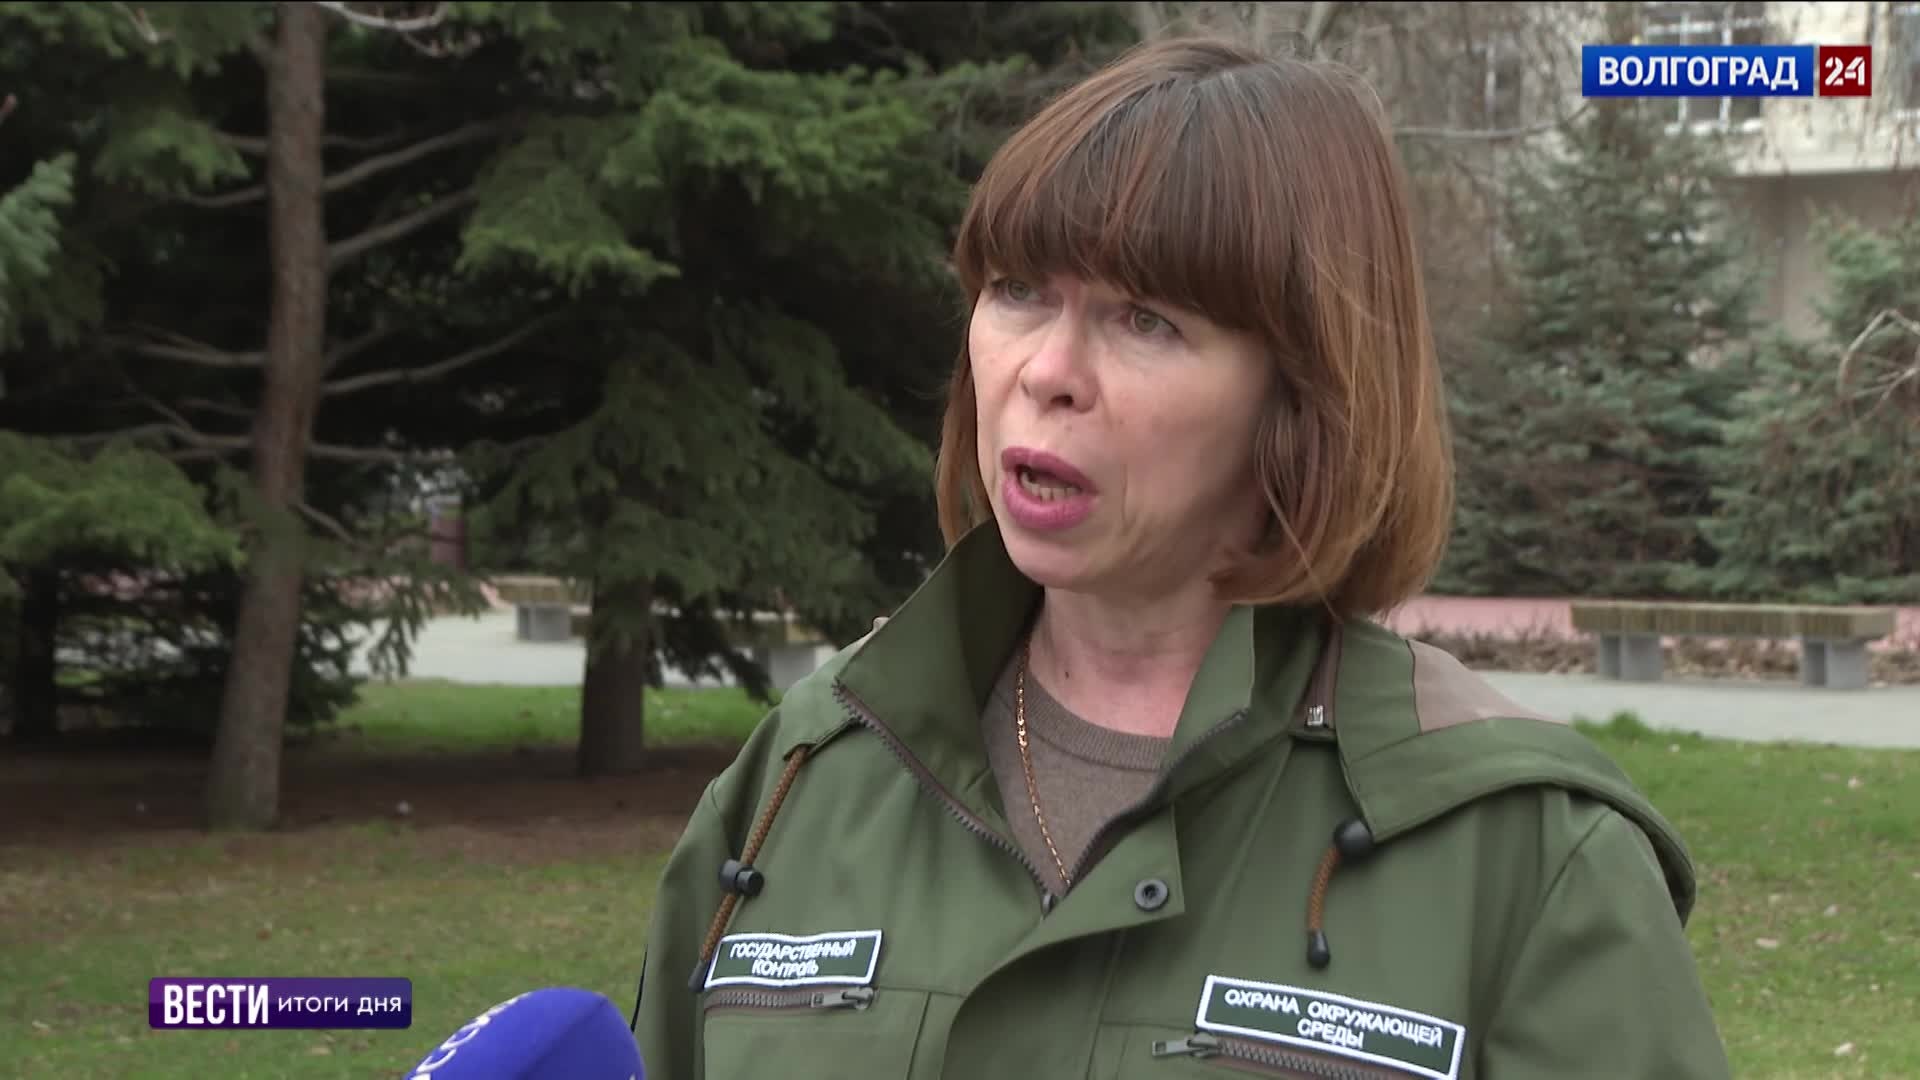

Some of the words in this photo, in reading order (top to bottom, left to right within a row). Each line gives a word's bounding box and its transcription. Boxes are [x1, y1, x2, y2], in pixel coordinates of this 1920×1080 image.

[729, 938, 857, 961] ГОСУДАРСТВЕННЫЙ
[751, 959, 819, 978] КОНТРОЛЬ
[1224, 989, 1300, 1015] ОХРАНА
[1307, 1001, 1442, 1048] ОКРУЖАЮЩЕЙ
[1297, 1018, 1363, 1049] СРЕДЫ
